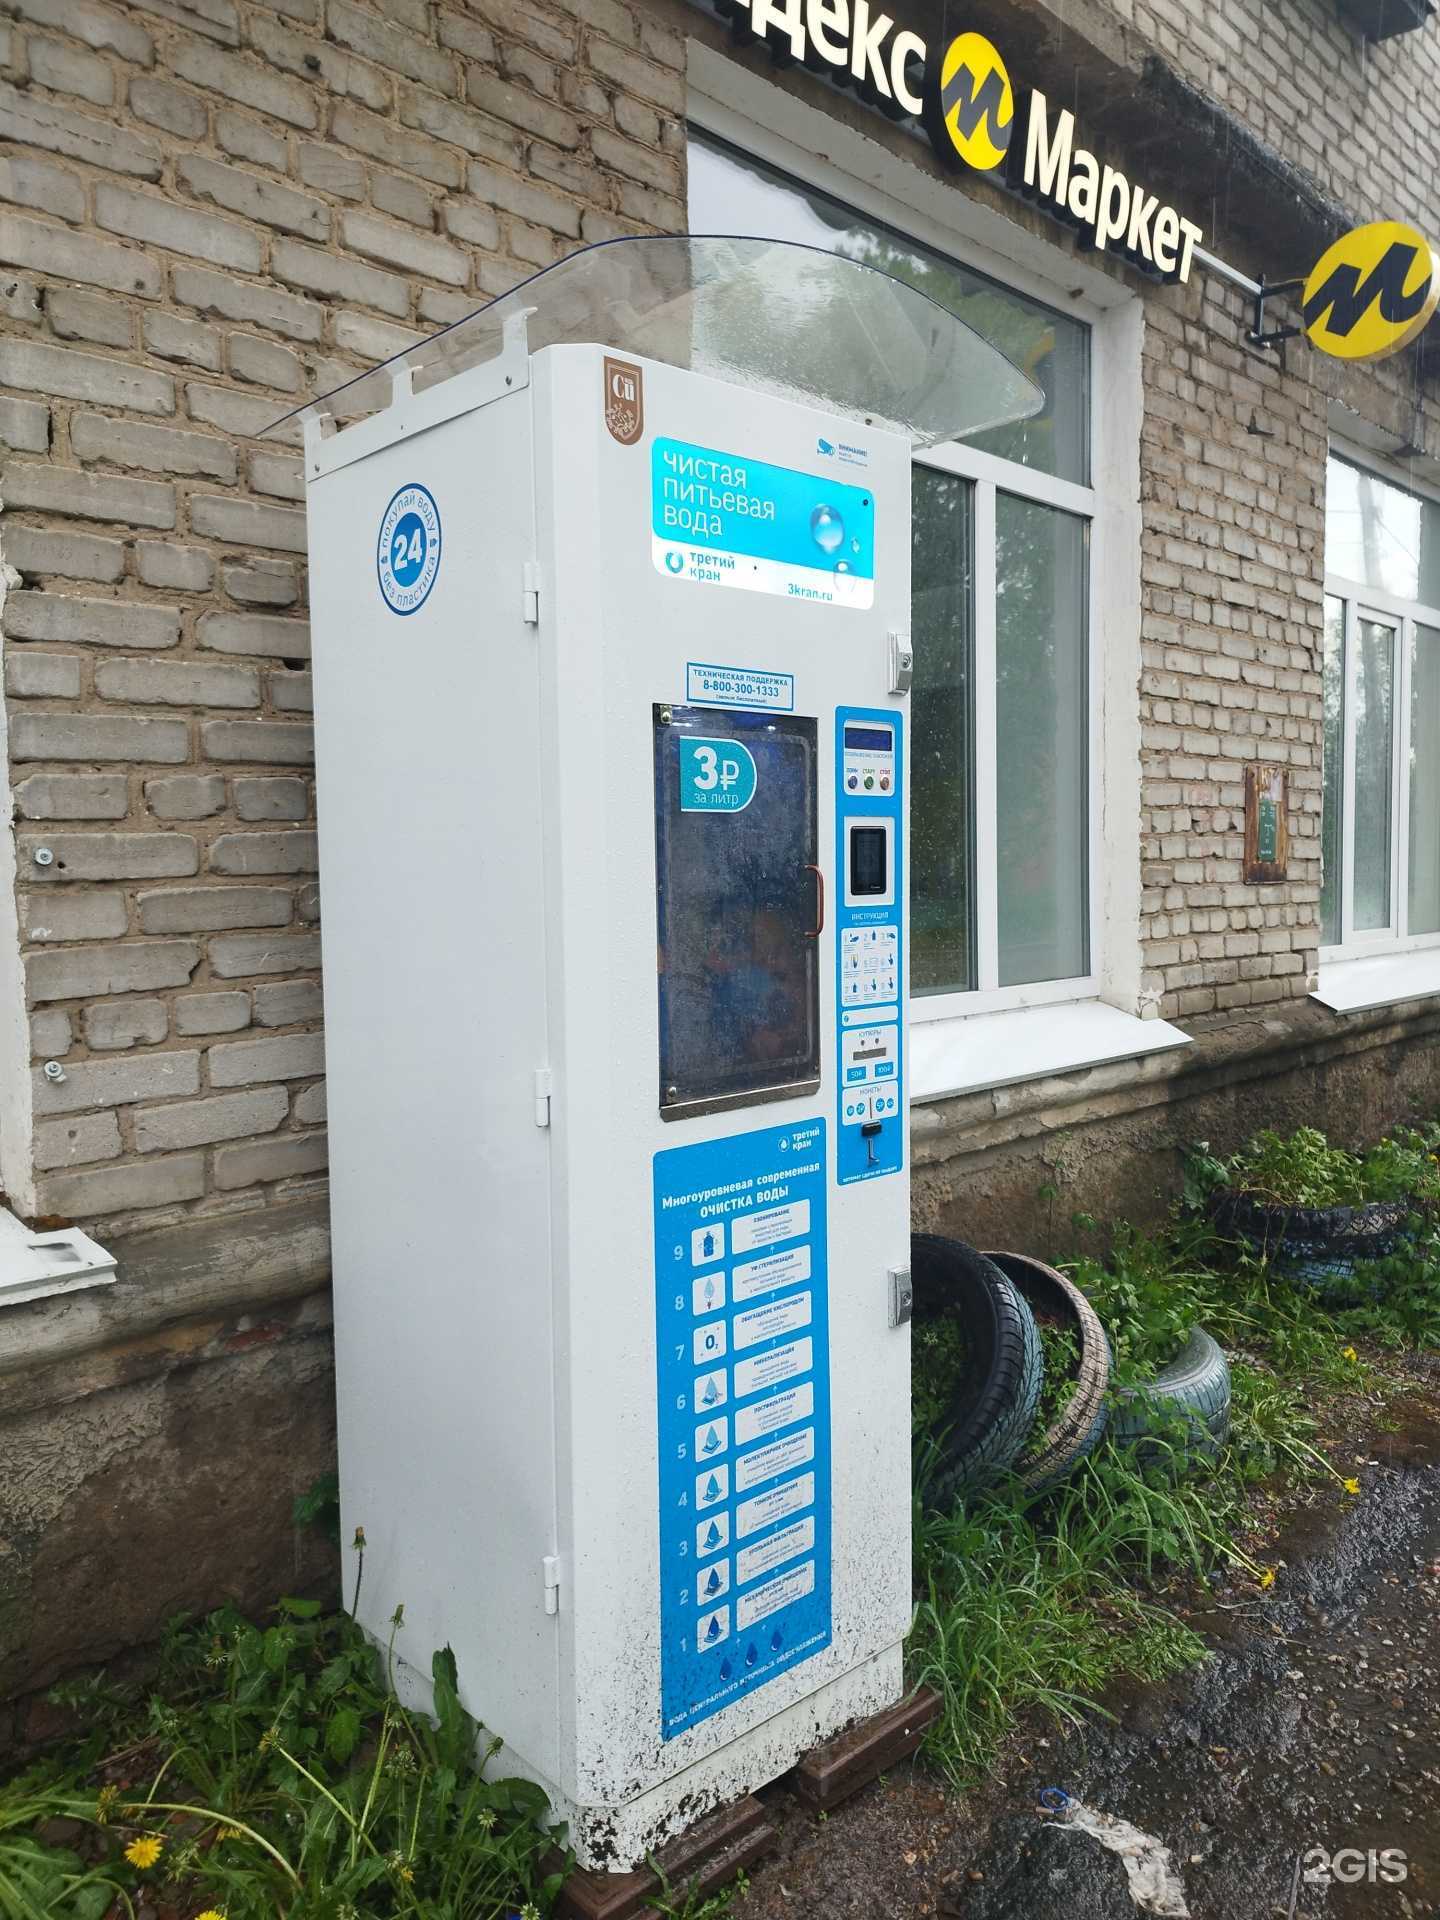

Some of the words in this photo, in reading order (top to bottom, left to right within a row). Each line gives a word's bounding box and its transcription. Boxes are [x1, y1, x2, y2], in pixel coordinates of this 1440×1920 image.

[1023, 88, 1203, 284] Маркет
[382, 491, 416, 548] покупай
[416, 496, 436, 531] воду
[393, 528, 423, 571] 24
[690, 551, 736, 570] третий
[383, 570, 396, 599] без
[396, 556, 436, 609] пластика
[690, 566, 721, 582] кран
[787, 582, 833, 601] 3kran.ru
[693, 669, 745, 681] ТЕХНИЧЕСКАЯ
[746, 675, 788, 686] ПОДДЕРЖКА
[703, 680, 779, 697] 8-800-300-1333
[693, 792, 707, 804] за
[711, 792, 740, 808] литр
[792, 1126, 820, 1141] третий
[792, 1139, 812, 1151] кран
[662, 1178, 753, 1209] Многоуровневая
[756, 1162, 820, 1186] современная
[700, 1196, 753, 1218] ОЧИСТКА
[756, 1185, 789, 1204] ВОДЫ
[674, 1245, 684, 1260] 9
[675, 1295, 685, 1311] 8
[675, 1344, 685, 1361] 7
[676, 1394, 687, 1410] 6
[677, 1443, 687, 1459] 5
[677, 1491, 688, 1507] 4
[679, 1540, 688, 1556] 3
[679, 1589, 689, 1606] 2
[680, 1637, 687, 1652] 1
